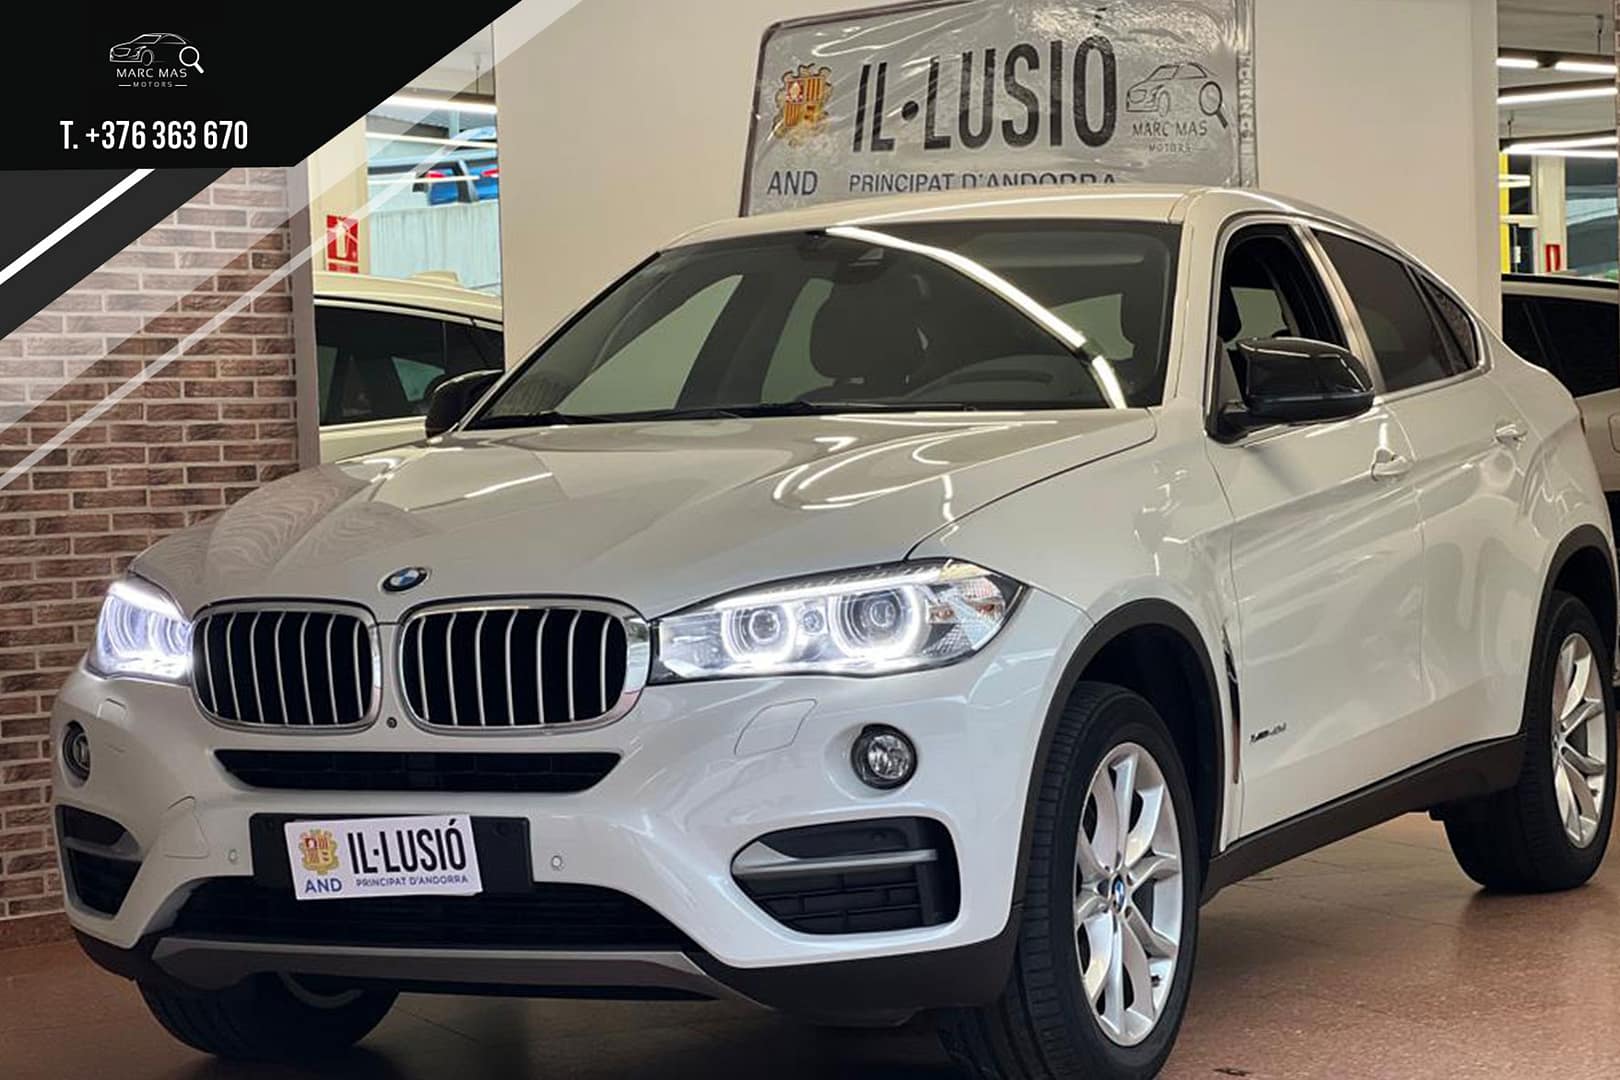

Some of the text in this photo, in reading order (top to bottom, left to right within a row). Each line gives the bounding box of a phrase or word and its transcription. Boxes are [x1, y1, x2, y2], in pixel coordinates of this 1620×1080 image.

[1132, 119, 1208, 137] MARC MAS
[766, 170, 818, 195] AND
[849, 173, 954, 193] PRINCIPAT
[304, 874, 469, 893] AND PRINCIPAT D'ANDORRA
